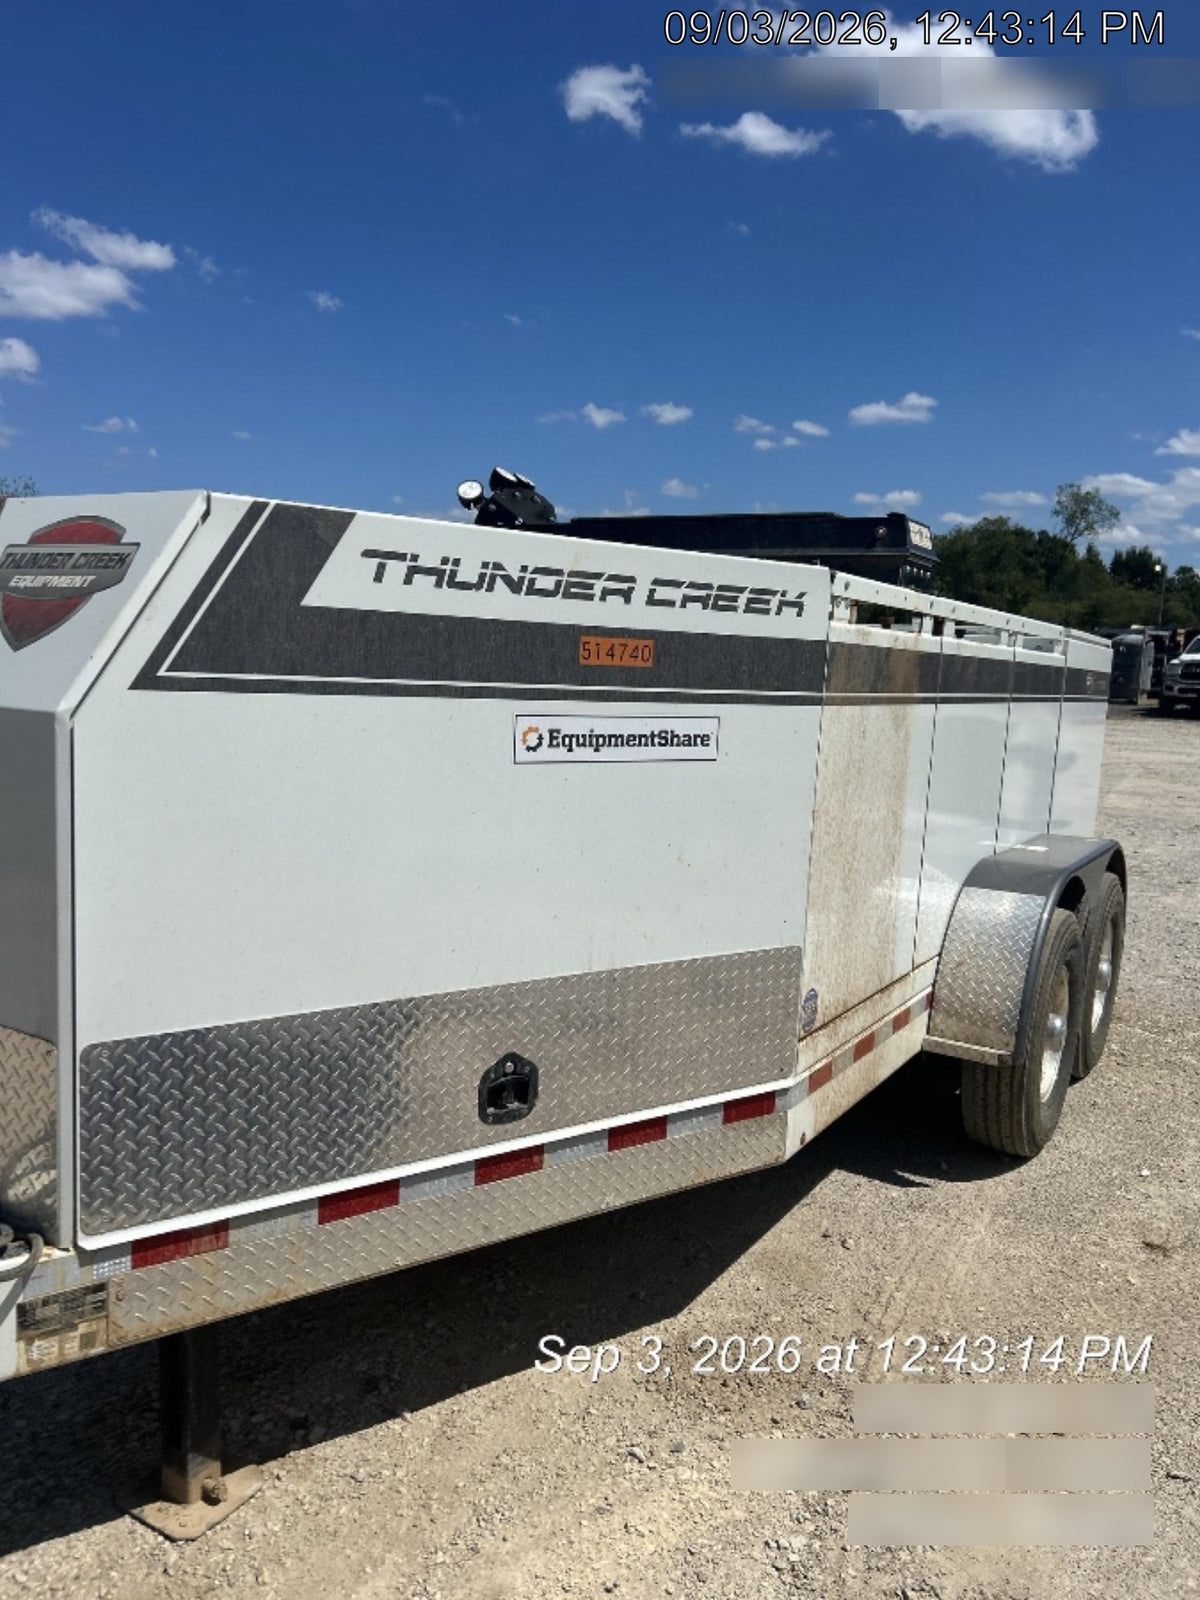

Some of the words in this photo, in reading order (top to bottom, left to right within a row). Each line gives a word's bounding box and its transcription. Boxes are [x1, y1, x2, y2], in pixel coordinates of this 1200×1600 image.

[0, 552, 76, 570] THUNDER
[70, 552, 132, 570] CREEK
[8, 575, 97, 588] EQUIPMENT
[360, 548, 637, 604] THUNDER
[645, 577, 807, 617] CREEK
[580, 640, 652, 663] 514740
[547, 727, 711, 752] EquipmentShare
